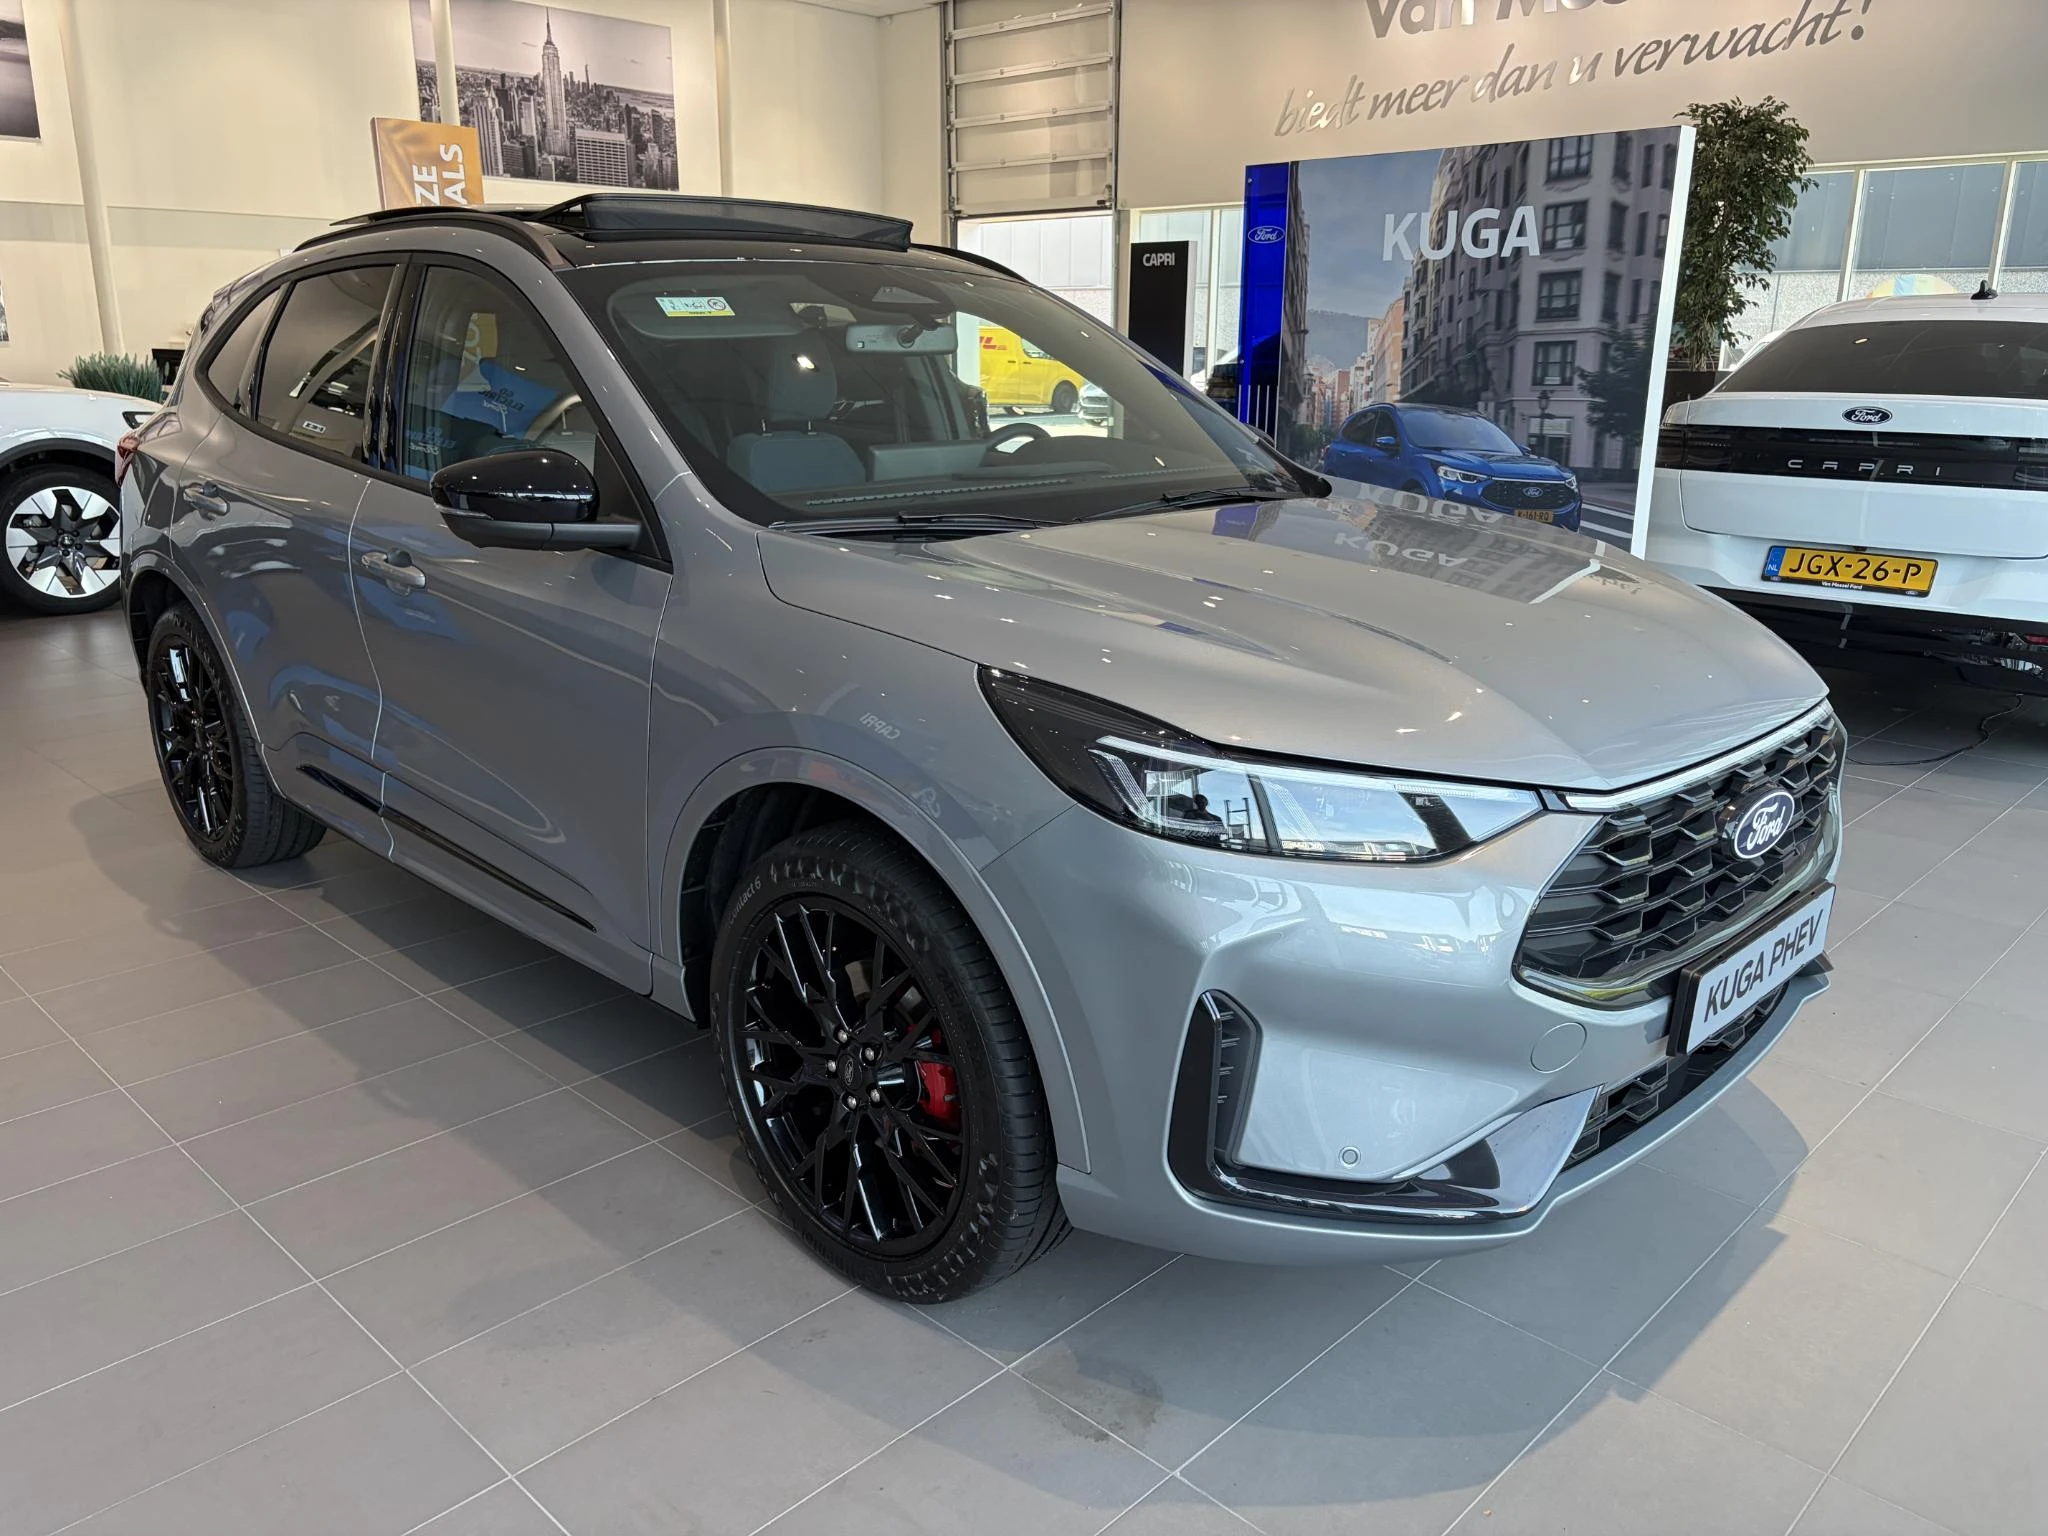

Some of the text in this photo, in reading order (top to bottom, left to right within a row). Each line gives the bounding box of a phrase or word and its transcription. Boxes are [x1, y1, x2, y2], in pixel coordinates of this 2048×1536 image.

[1273, 0, 1872, 137] biedt meer dan u verwacht!
[412, 164, 441, 206] ZE
[440, 143, 468, 207] ALS
[1254, 228, 1277, 241] Ford
[1382, 204, 1541, 262] KUGA
[1142, 252, 1176, 267] CAPRI
[1851, 408, 1881, 422] Ford
[1787, 459, 1941, 477] CAPRI
[1767, 564, 1779, 573] NL
[1789, 553, 1922, 584] JGX-26-P
[1703, 908, 1824, 1024] KUGA PHEV
